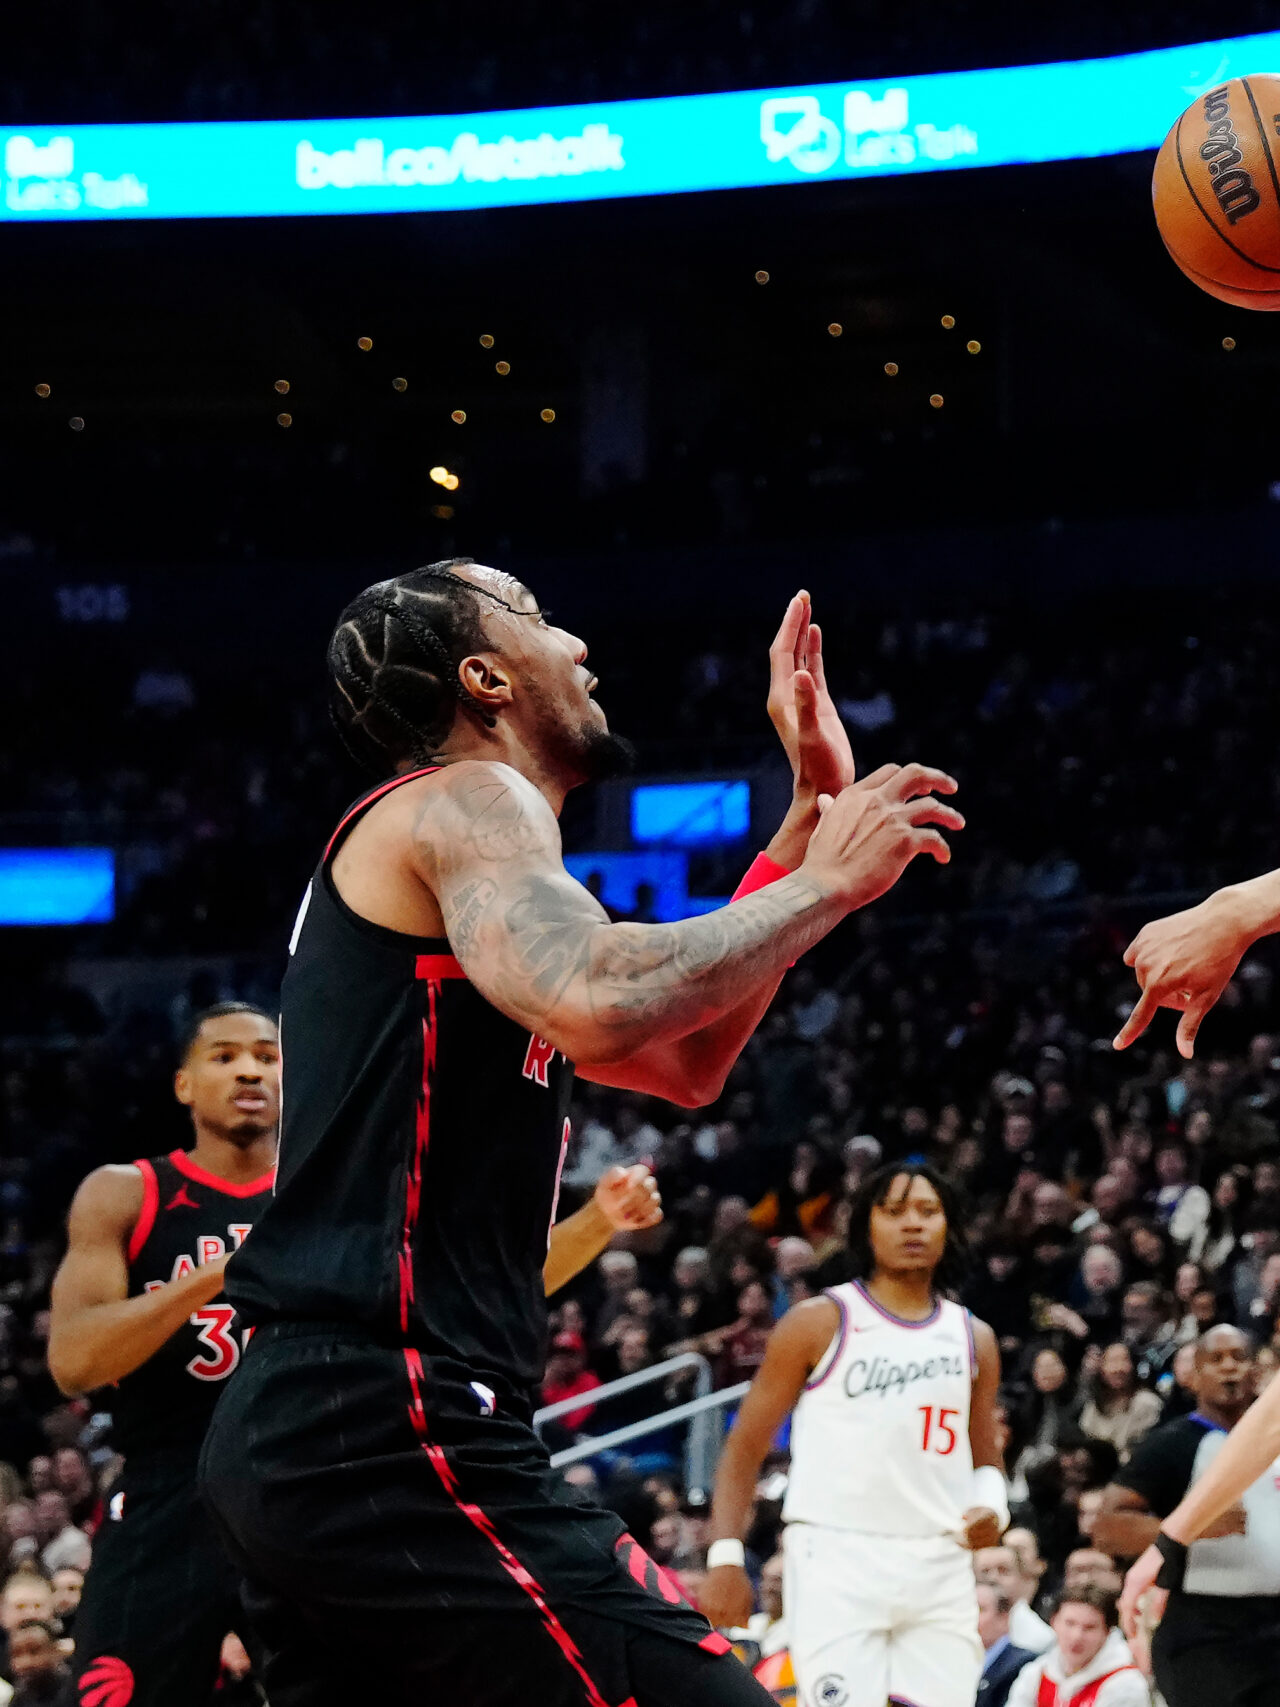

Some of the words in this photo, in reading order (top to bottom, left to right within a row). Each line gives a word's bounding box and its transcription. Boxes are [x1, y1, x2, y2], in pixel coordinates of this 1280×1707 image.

[1200, 87, 1261, 226] Wilson
[145, 1223, 253, 1294] APT
[186, 1303, 256, 1382] 3
[843, 1354, 963, 1398] Clippers
[917, 1404, 961, 1456] 15
